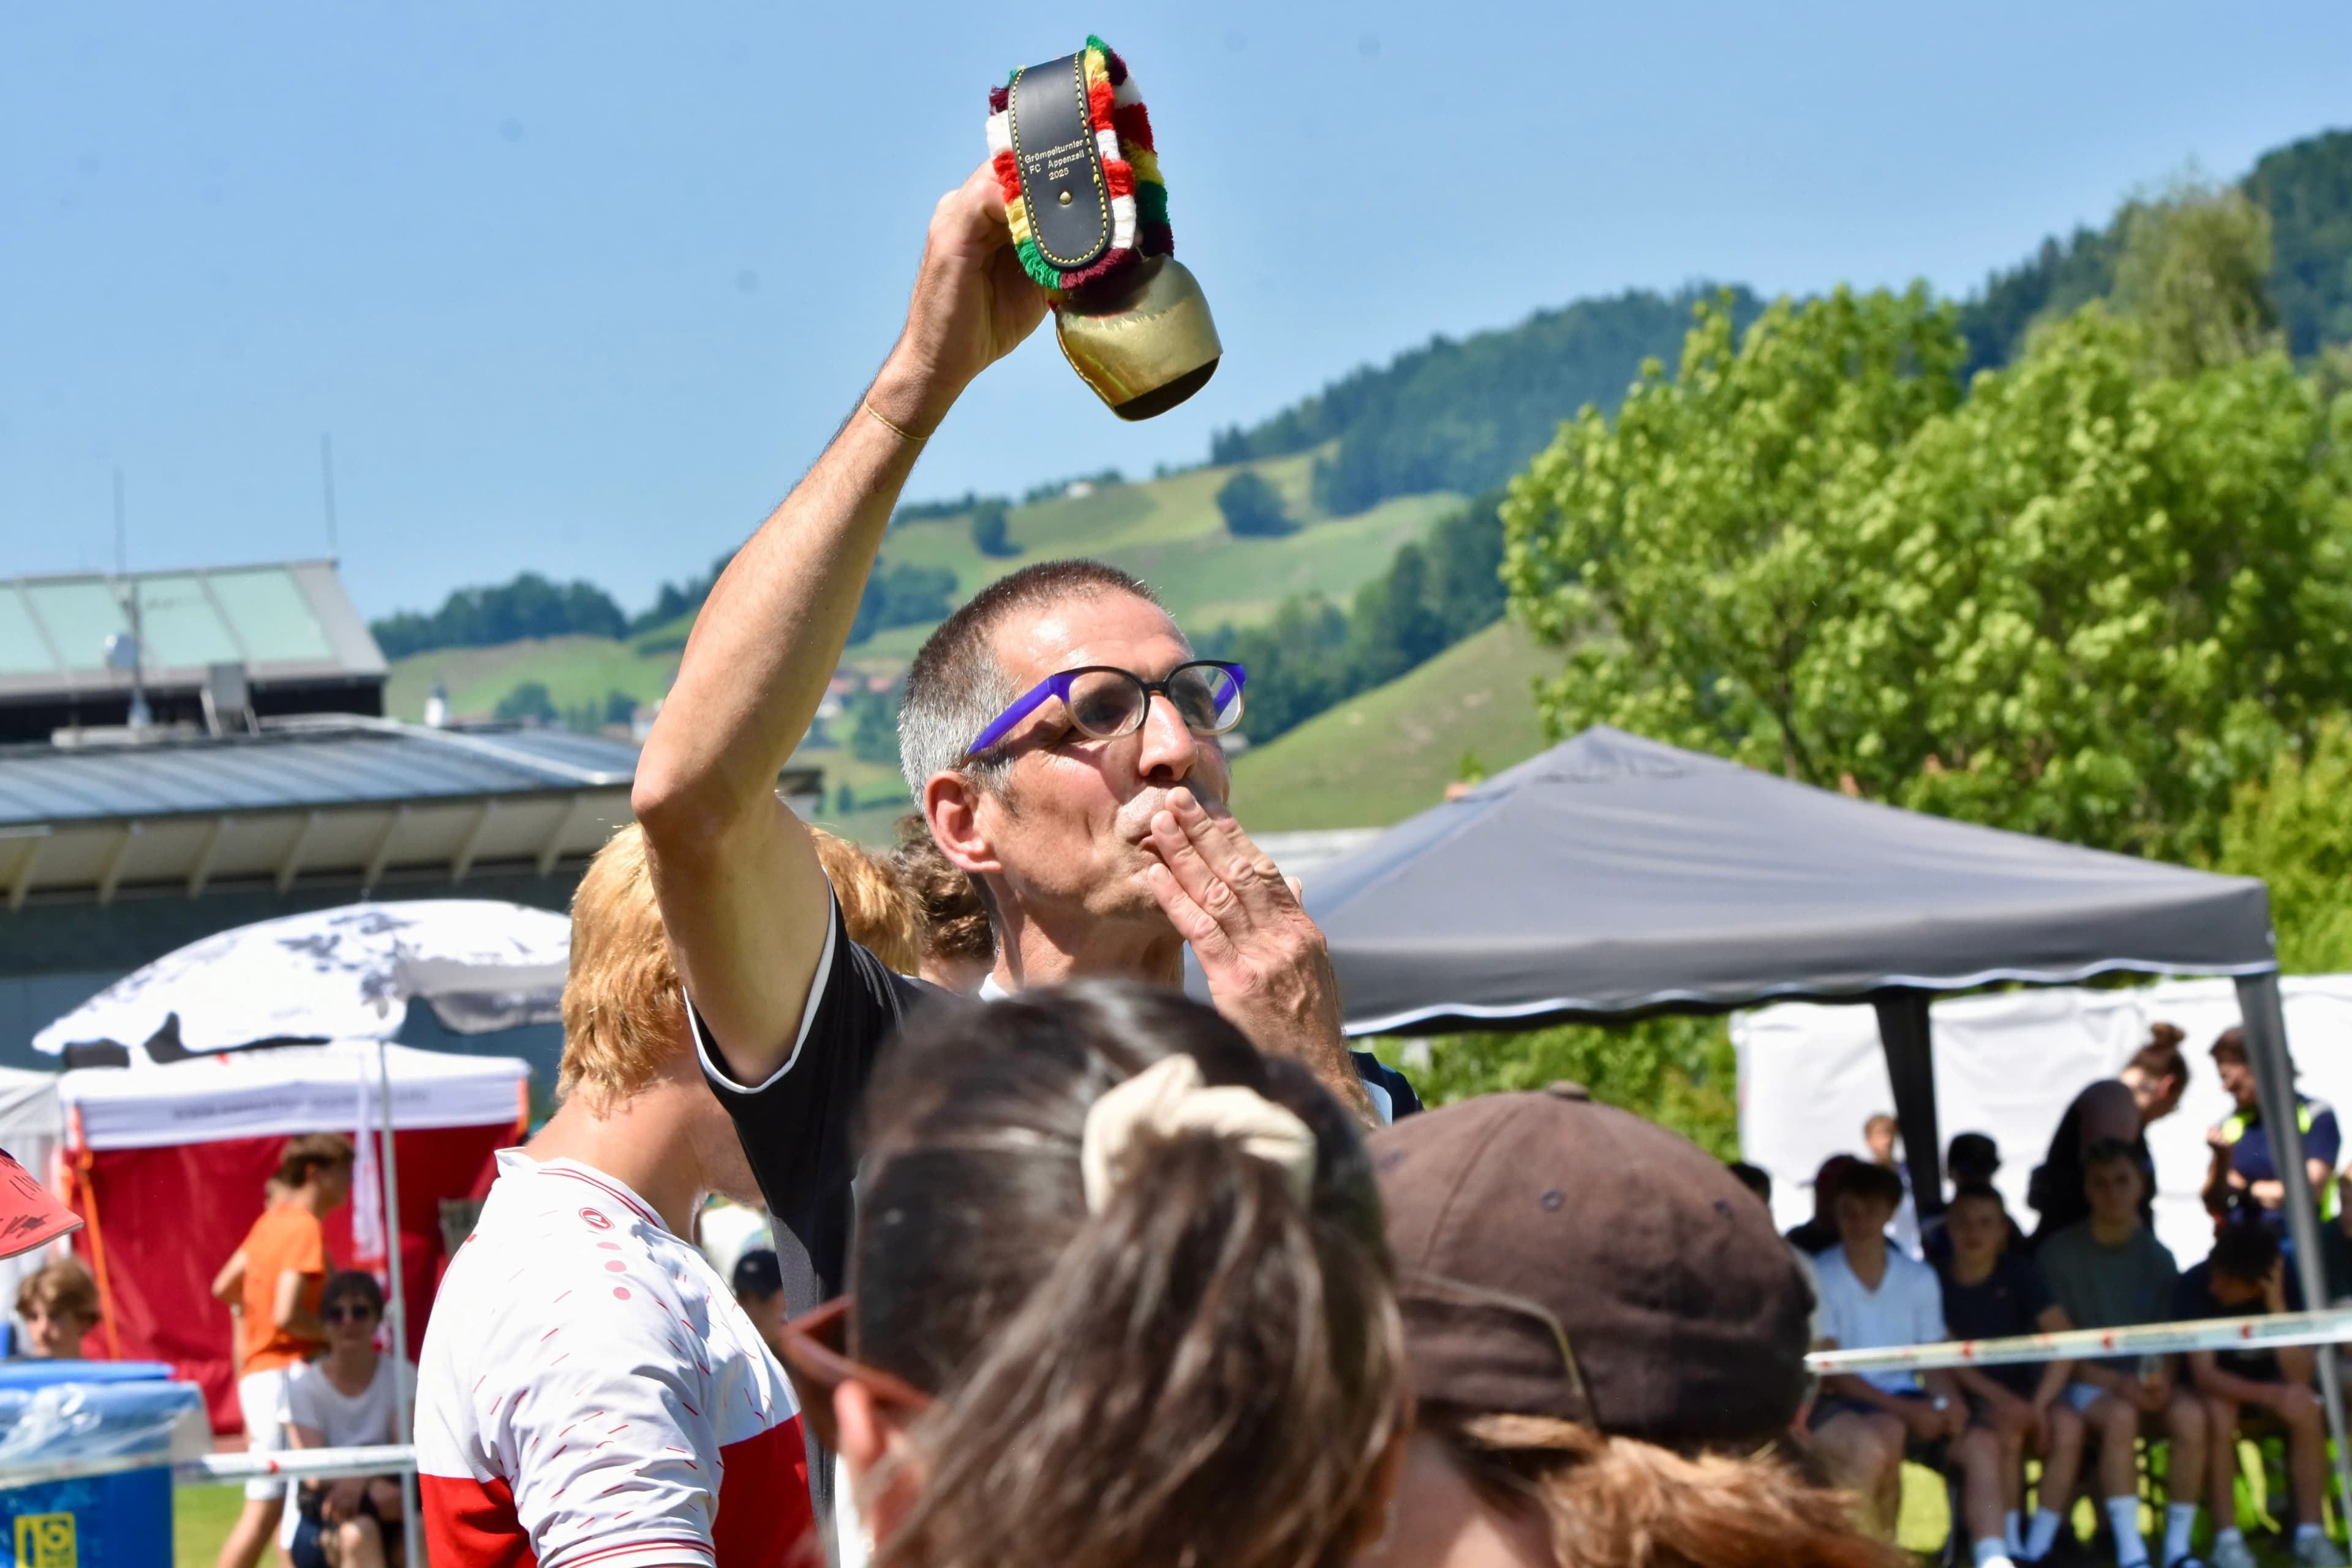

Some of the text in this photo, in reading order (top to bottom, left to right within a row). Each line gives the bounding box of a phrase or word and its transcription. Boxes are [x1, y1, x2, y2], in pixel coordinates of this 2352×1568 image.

[1029, 149, 1085, 175] FC Appenzell
[1049, 167, 1069, 181] 2025
